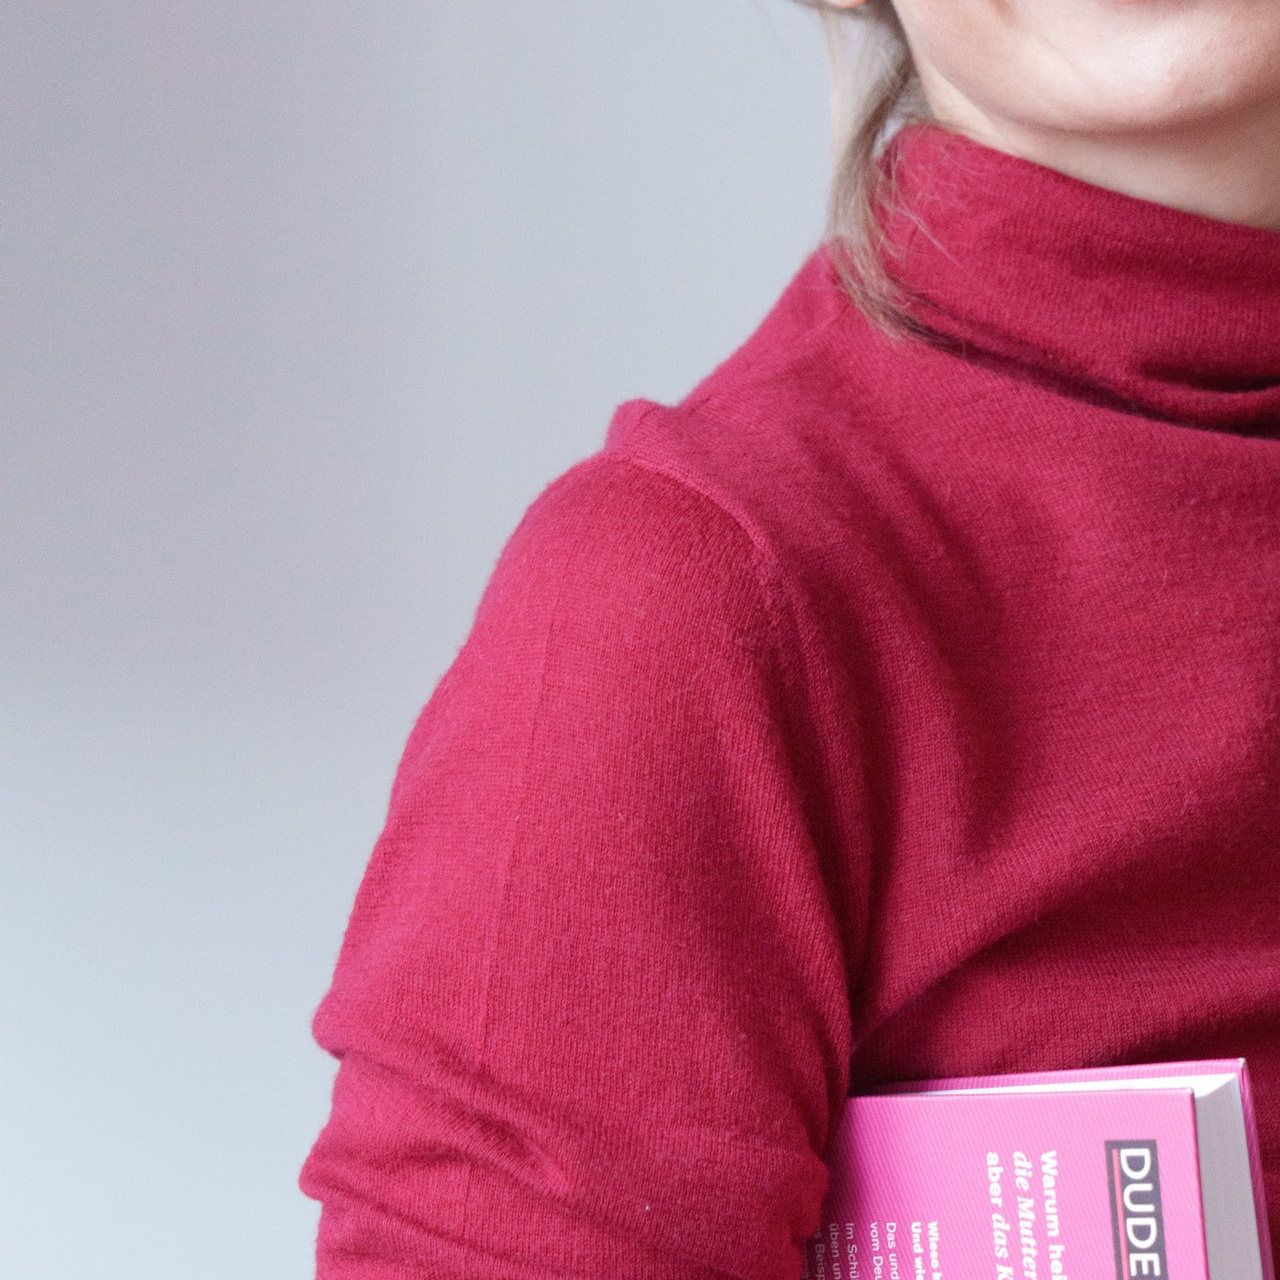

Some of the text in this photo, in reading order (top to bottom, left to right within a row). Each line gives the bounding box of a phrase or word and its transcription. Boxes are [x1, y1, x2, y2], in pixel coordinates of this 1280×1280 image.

[987, 1152, 1003, 1206] aber
[1013, 1151, 1032, 1191] die
[1041, 1150, 1058, 1236] Warum
[829, 1223, 841, 1258] üben
[846, 1223, 856, 1239] Im
[870, 1222, 879, 1250] vom
[886, 1222, 897, 1248] Das
[911, 1222, 924, 1253] Und
[928, 1221, 939, 1268] Wieso
[992, 1213, 1011, 1258] das
[889, 1253, 899, 1280] und
